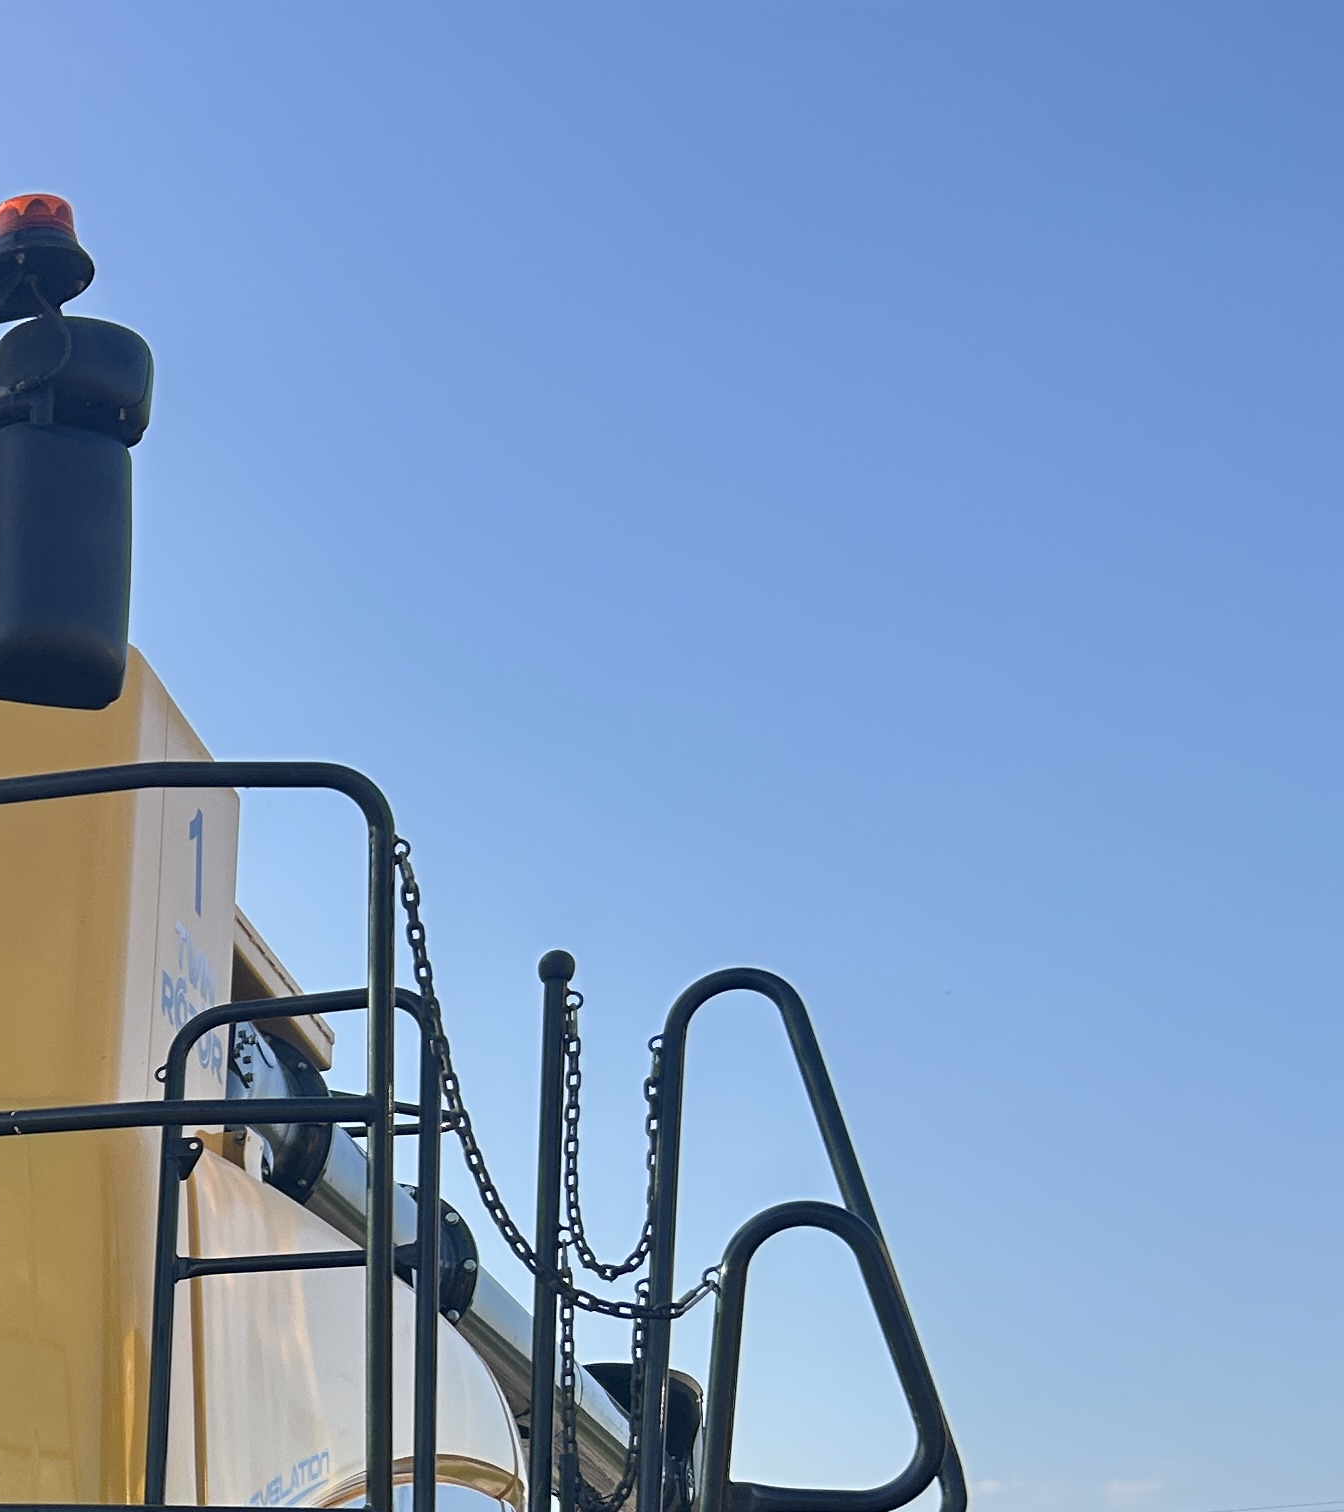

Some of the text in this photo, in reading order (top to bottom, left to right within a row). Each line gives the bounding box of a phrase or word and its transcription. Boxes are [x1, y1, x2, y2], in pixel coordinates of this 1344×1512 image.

[188, 807, 203, 917] 1
[174, 919, 217, 1006] TWIN
[161, 968, 223, 1085] ROOR
[250, 1449, 329, 1506] VELATION
